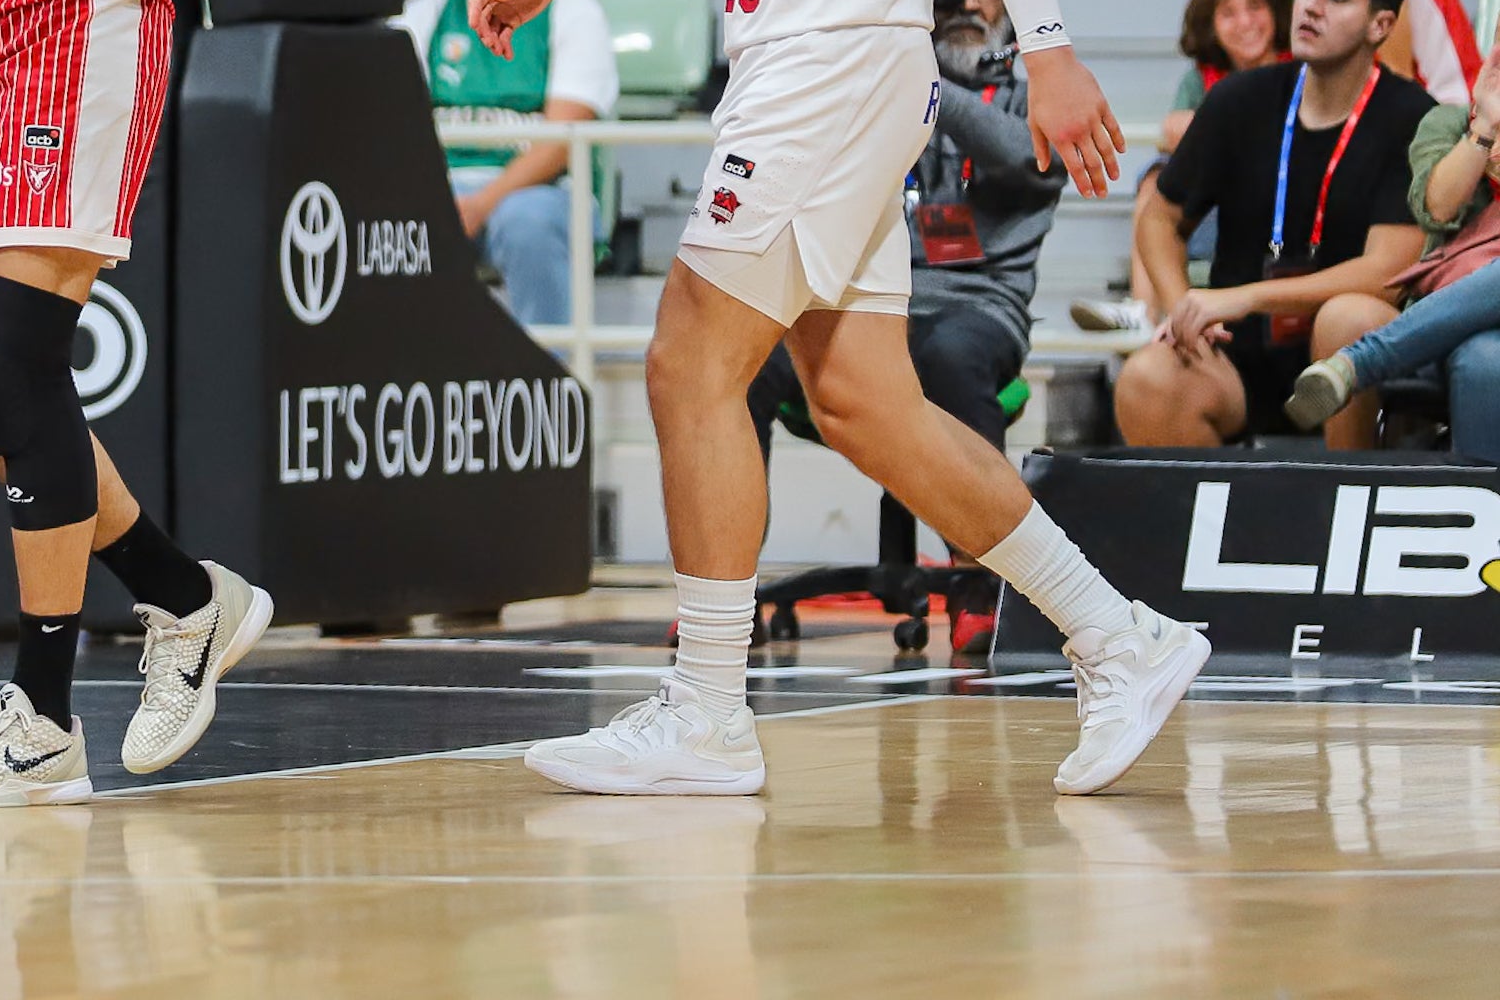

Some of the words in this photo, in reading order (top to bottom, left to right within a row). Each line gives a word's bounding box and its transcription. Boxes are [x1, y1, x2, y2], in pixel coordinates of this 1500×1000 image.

[27, 133, 54, 146] acb
[724, 161, 747, 177] acb
[356, 219, 432, 277] LABASA
[279, 383, 368, 484] LET'S
[374, 382, 436, 479] GO
[442, 376, 585, 475] BEYOND
